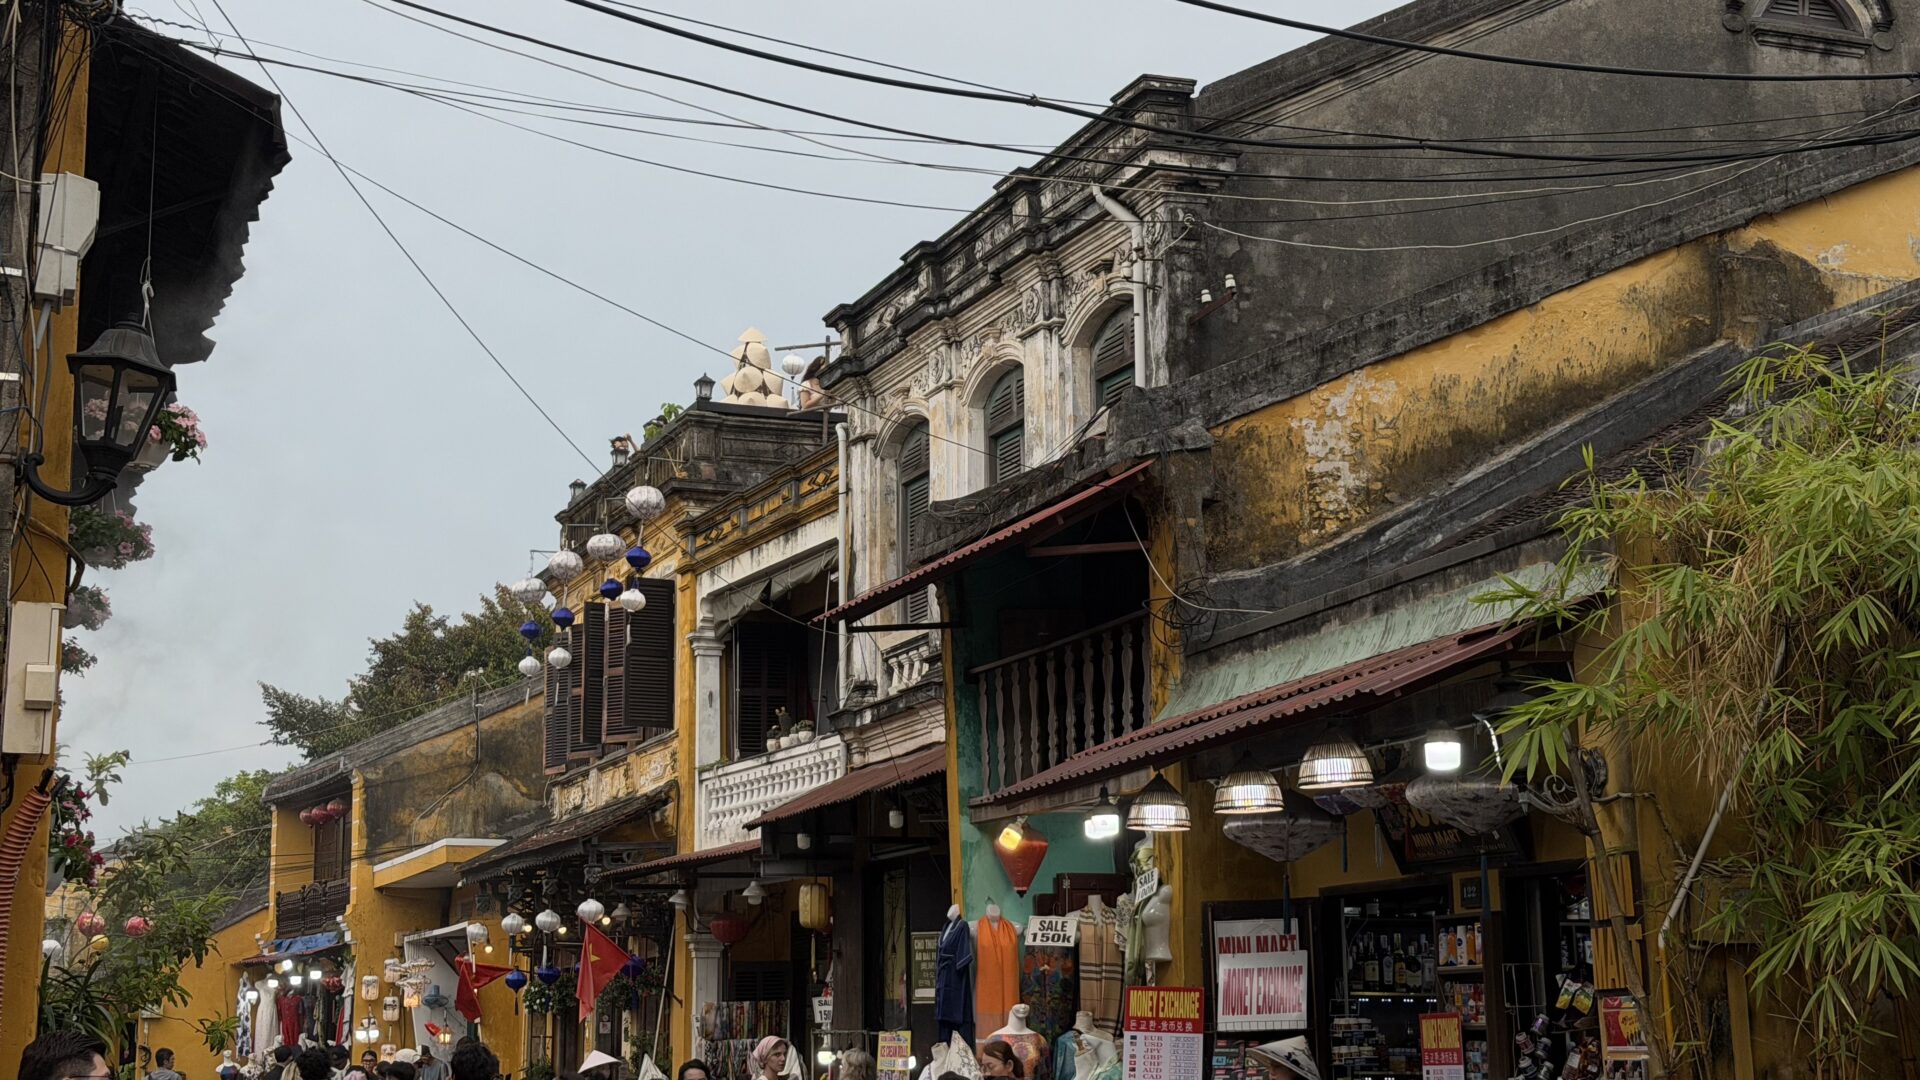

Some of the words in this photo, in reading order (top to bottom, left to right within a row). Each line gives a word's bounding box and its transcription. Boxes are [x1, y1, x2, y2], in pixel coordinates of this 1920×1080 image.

[1139, 871, 1155, 888] SALE
[1038, 919, 1068, 933] SALE
[1030, 932, 1072, 944] 150k
[1218, 935, 1251, 954] MINI
[1222, 967, 1255, 1016] MONEY
[1256, 965, 1303, 1015] EXCHANGE
[1129, 989, 1157, 1017] MONEY
[1158, 990, 1200, 1019] EXCHANGE
